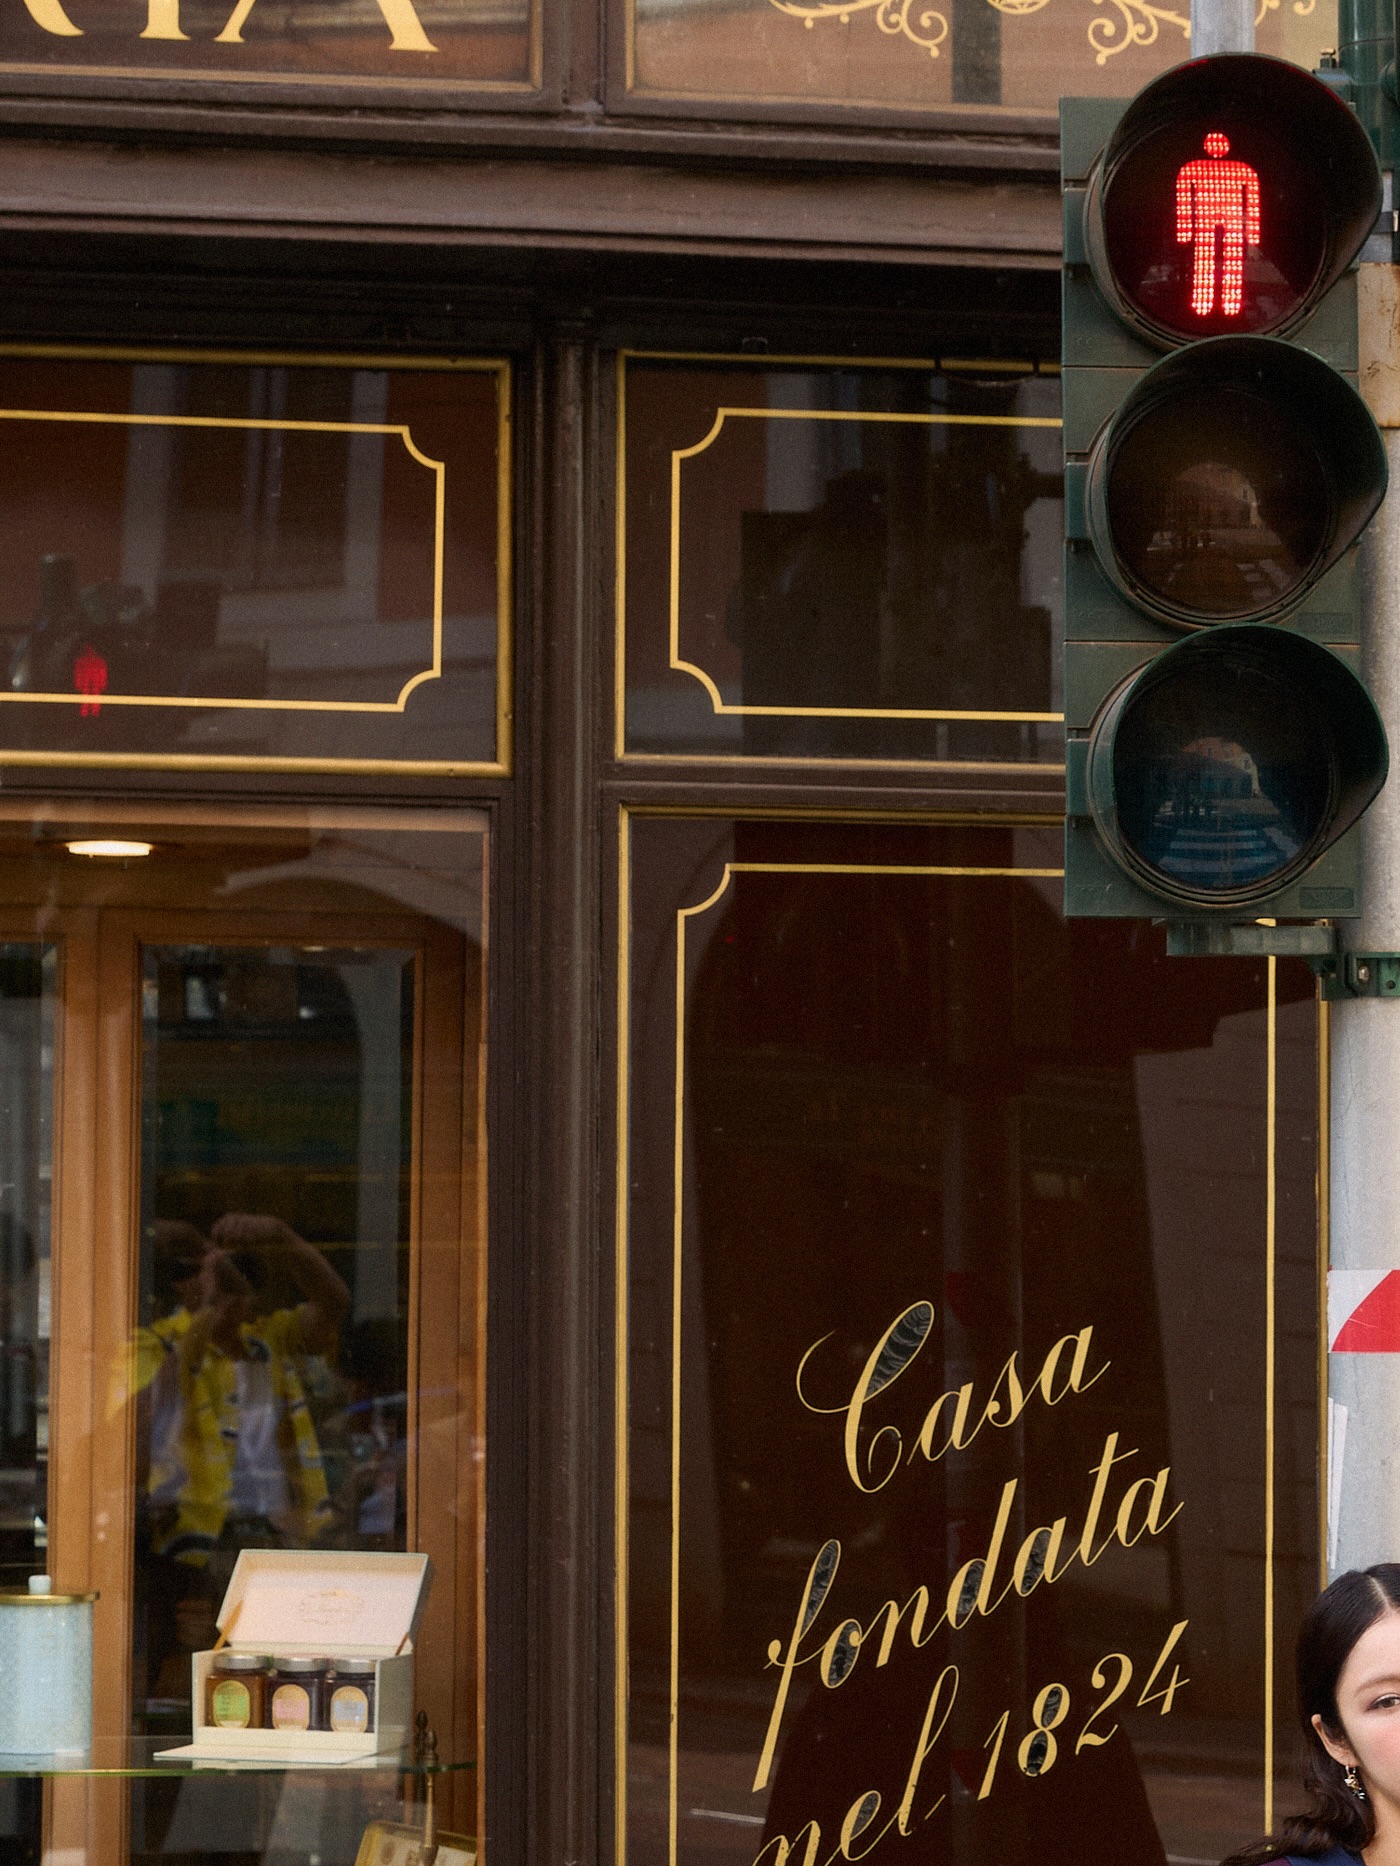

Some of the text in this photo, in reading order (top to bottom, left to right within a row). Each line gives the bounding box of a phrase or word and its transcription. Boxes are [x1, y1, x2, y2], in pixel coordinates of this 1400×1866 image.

[797, 1300, 1111, 1493] Casa
[752, 1431, 1185, 1793] fondata
[977, 1619, 1190, 1801] 1824
